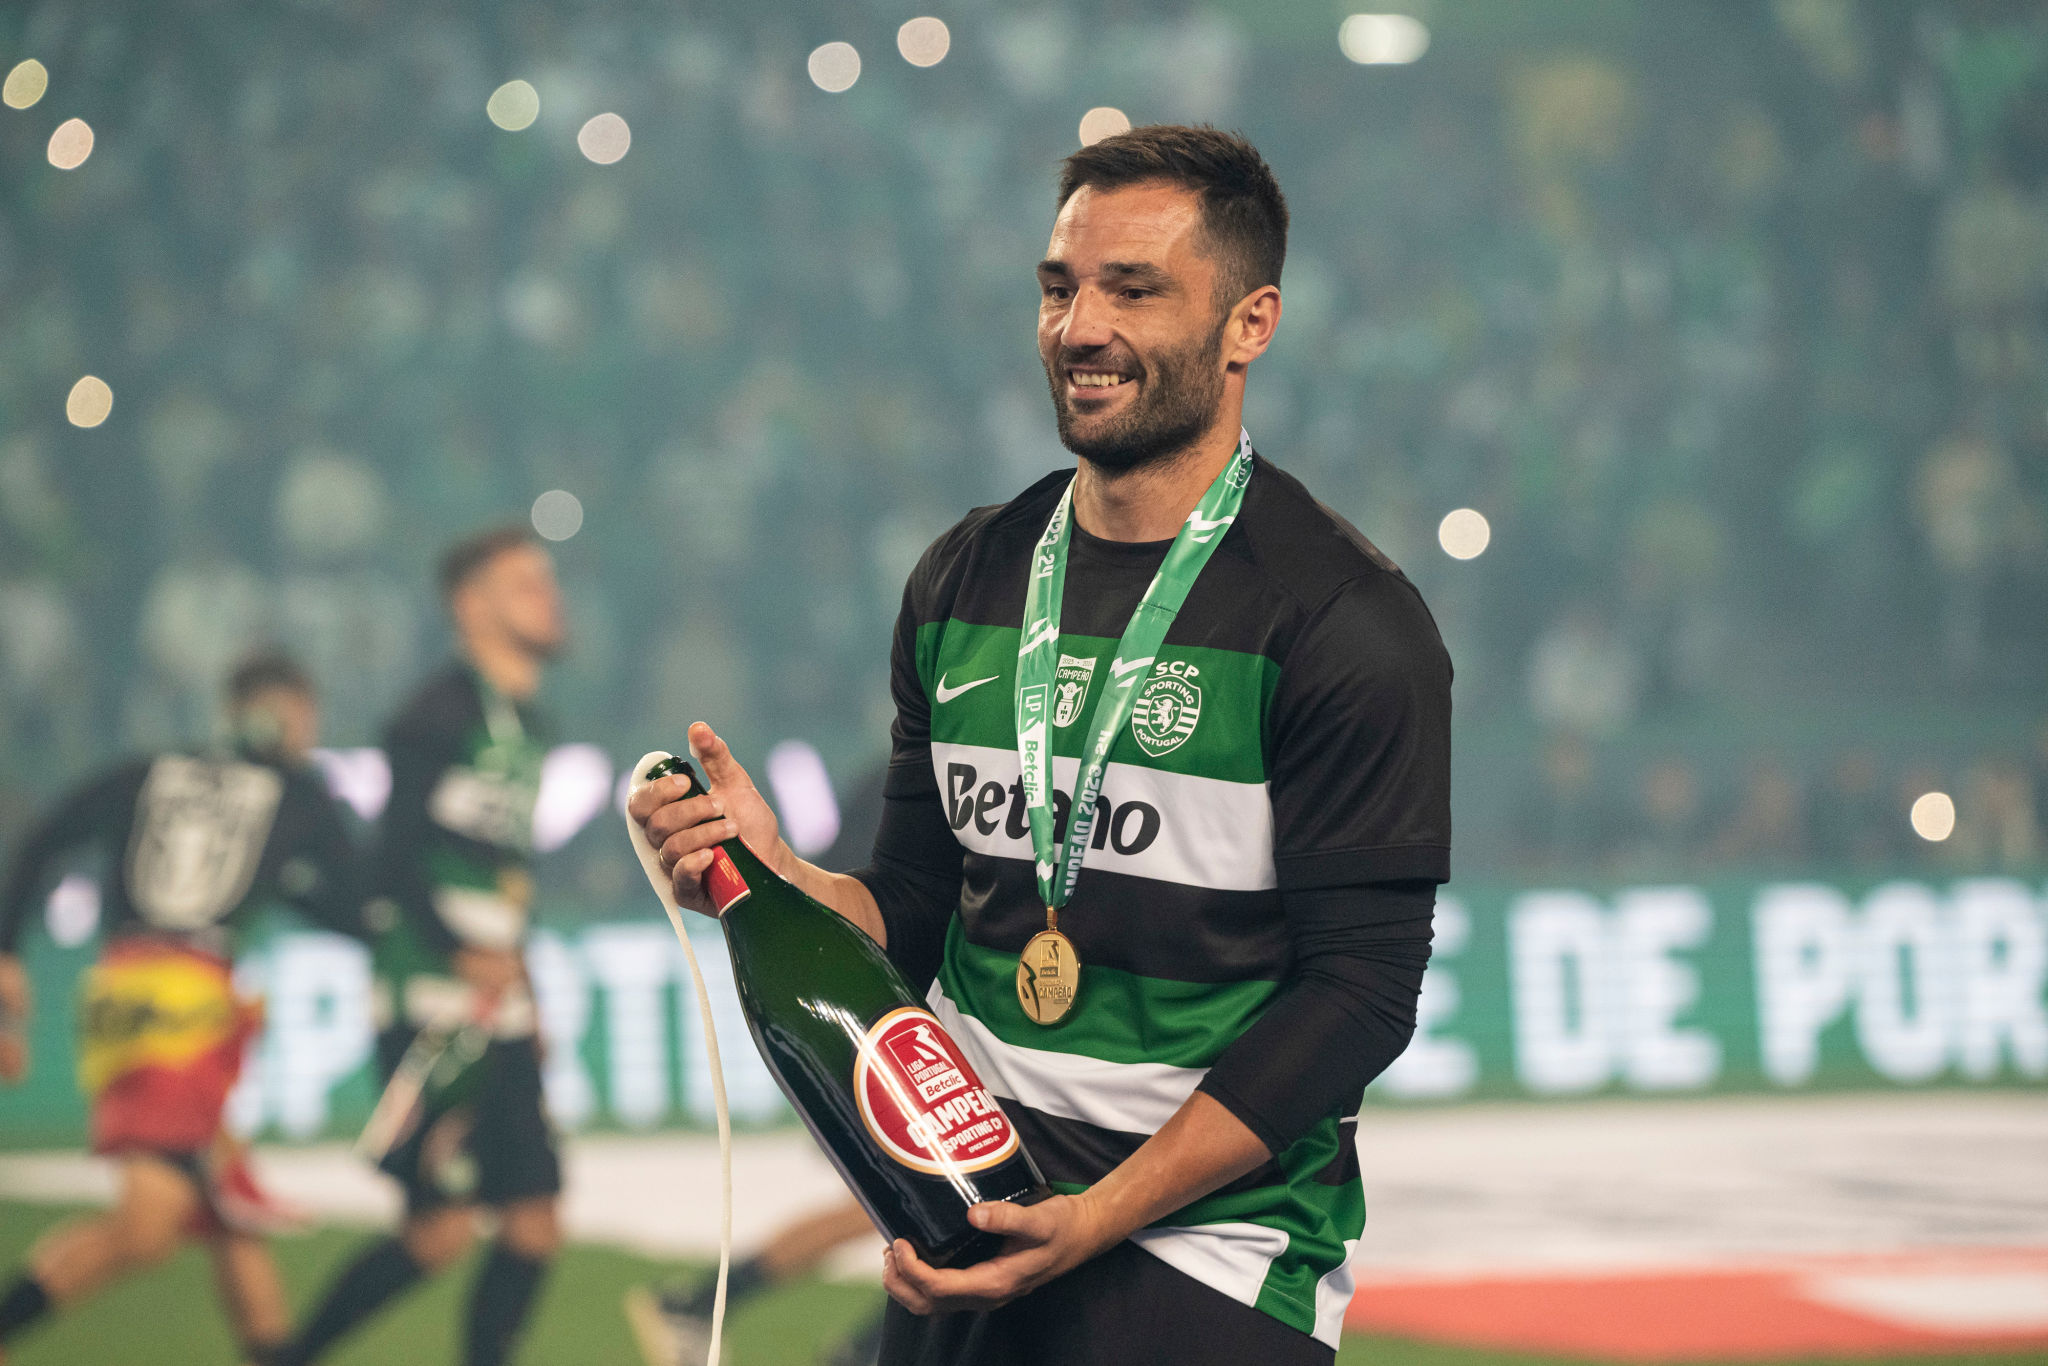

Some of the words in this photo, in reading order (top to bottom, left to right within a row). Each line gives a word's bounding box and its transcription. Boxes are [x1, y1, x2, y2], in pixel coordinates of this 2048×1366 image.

[1058, 668, 1090, 682] CAMPEÃO
[1155, 660, 1200, 679] SCP
[1144, 680, 1195, 705] SPORTING
[1136, 728, 1183, 747] PORTUGAL
[1023, 740, 1039, 802] Betclic
[1078, 730, 1113, 817] 2023-24
[1509, 886, 1720, 1091] DE
[1754, 879, 2048, 1084] POR
[906, 1058, 927, 1074] LIGA
[913, 1060, 950, 1084] PORTUGAL
[925, 1074, 962, 1097] Betclic
[906, 1086, 1001, 1148] CAMPEÃO
[942, 1120, 994, 1153] SPORTING
[990, 1117, 1003, 1130] CP
